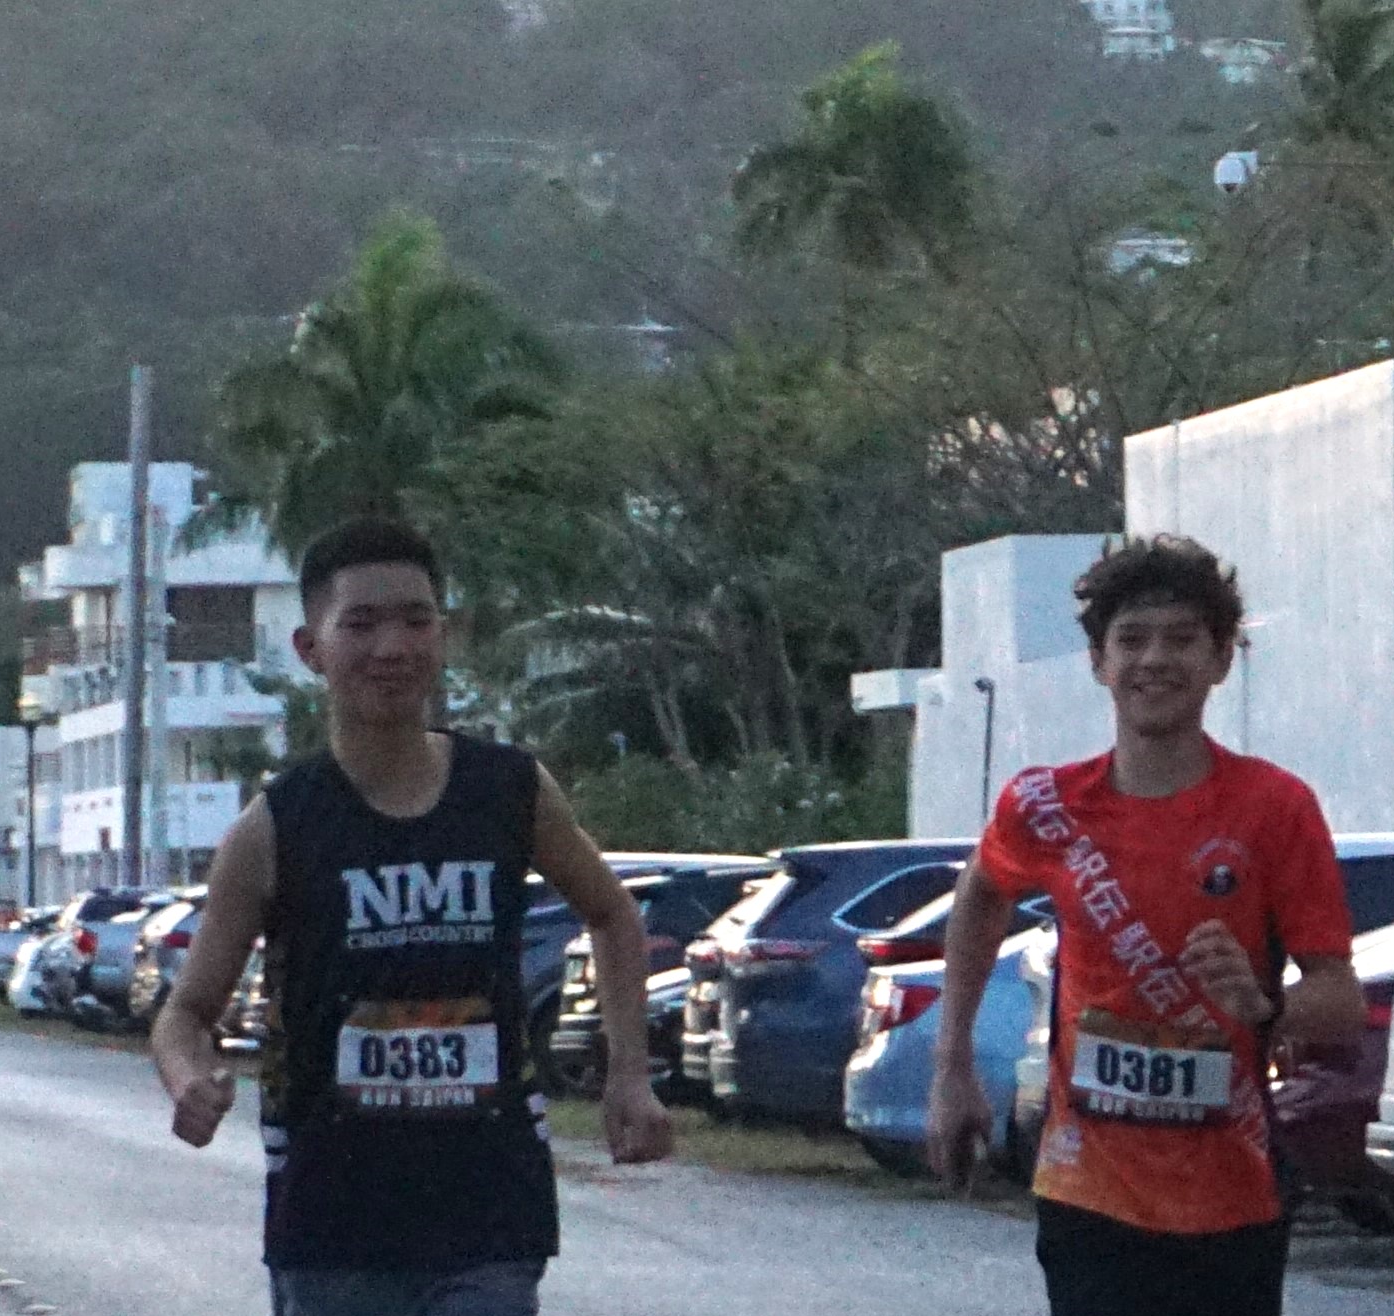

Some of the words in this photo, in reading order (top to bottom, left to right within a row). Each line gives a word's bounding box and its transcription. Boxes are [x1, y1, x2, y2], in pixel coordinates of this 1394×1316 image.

[342, 860, 495, 930] NMI
[359, 1032, 468, 1081] 0383
[1096, 1043, 1197, 1099] 0381
